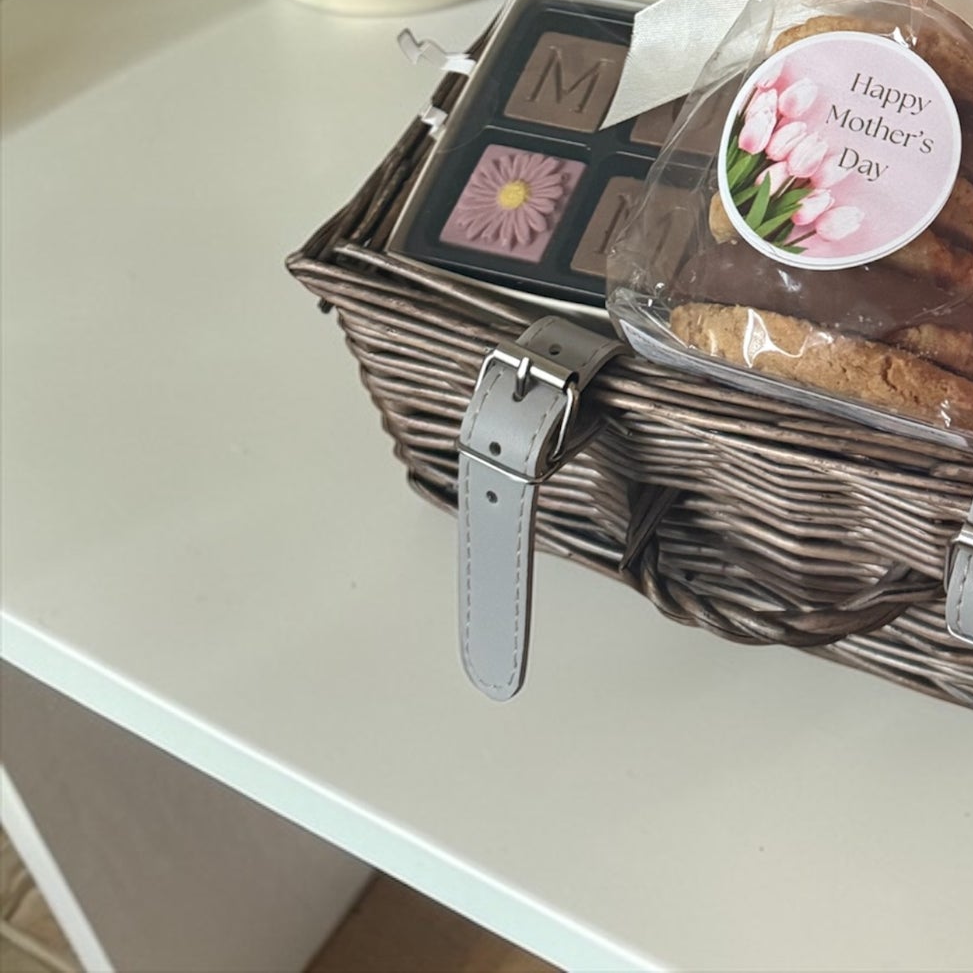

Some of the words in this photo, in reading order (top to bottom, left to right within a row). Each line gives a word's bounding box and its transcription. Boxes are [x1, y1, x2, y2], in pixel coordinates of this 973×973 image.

[524, 45, 616, 114] M
[849, 73, 932, 116] Happy
[826, 104, 935, 155] Mother's
[837, 147, 889, 183] Day
